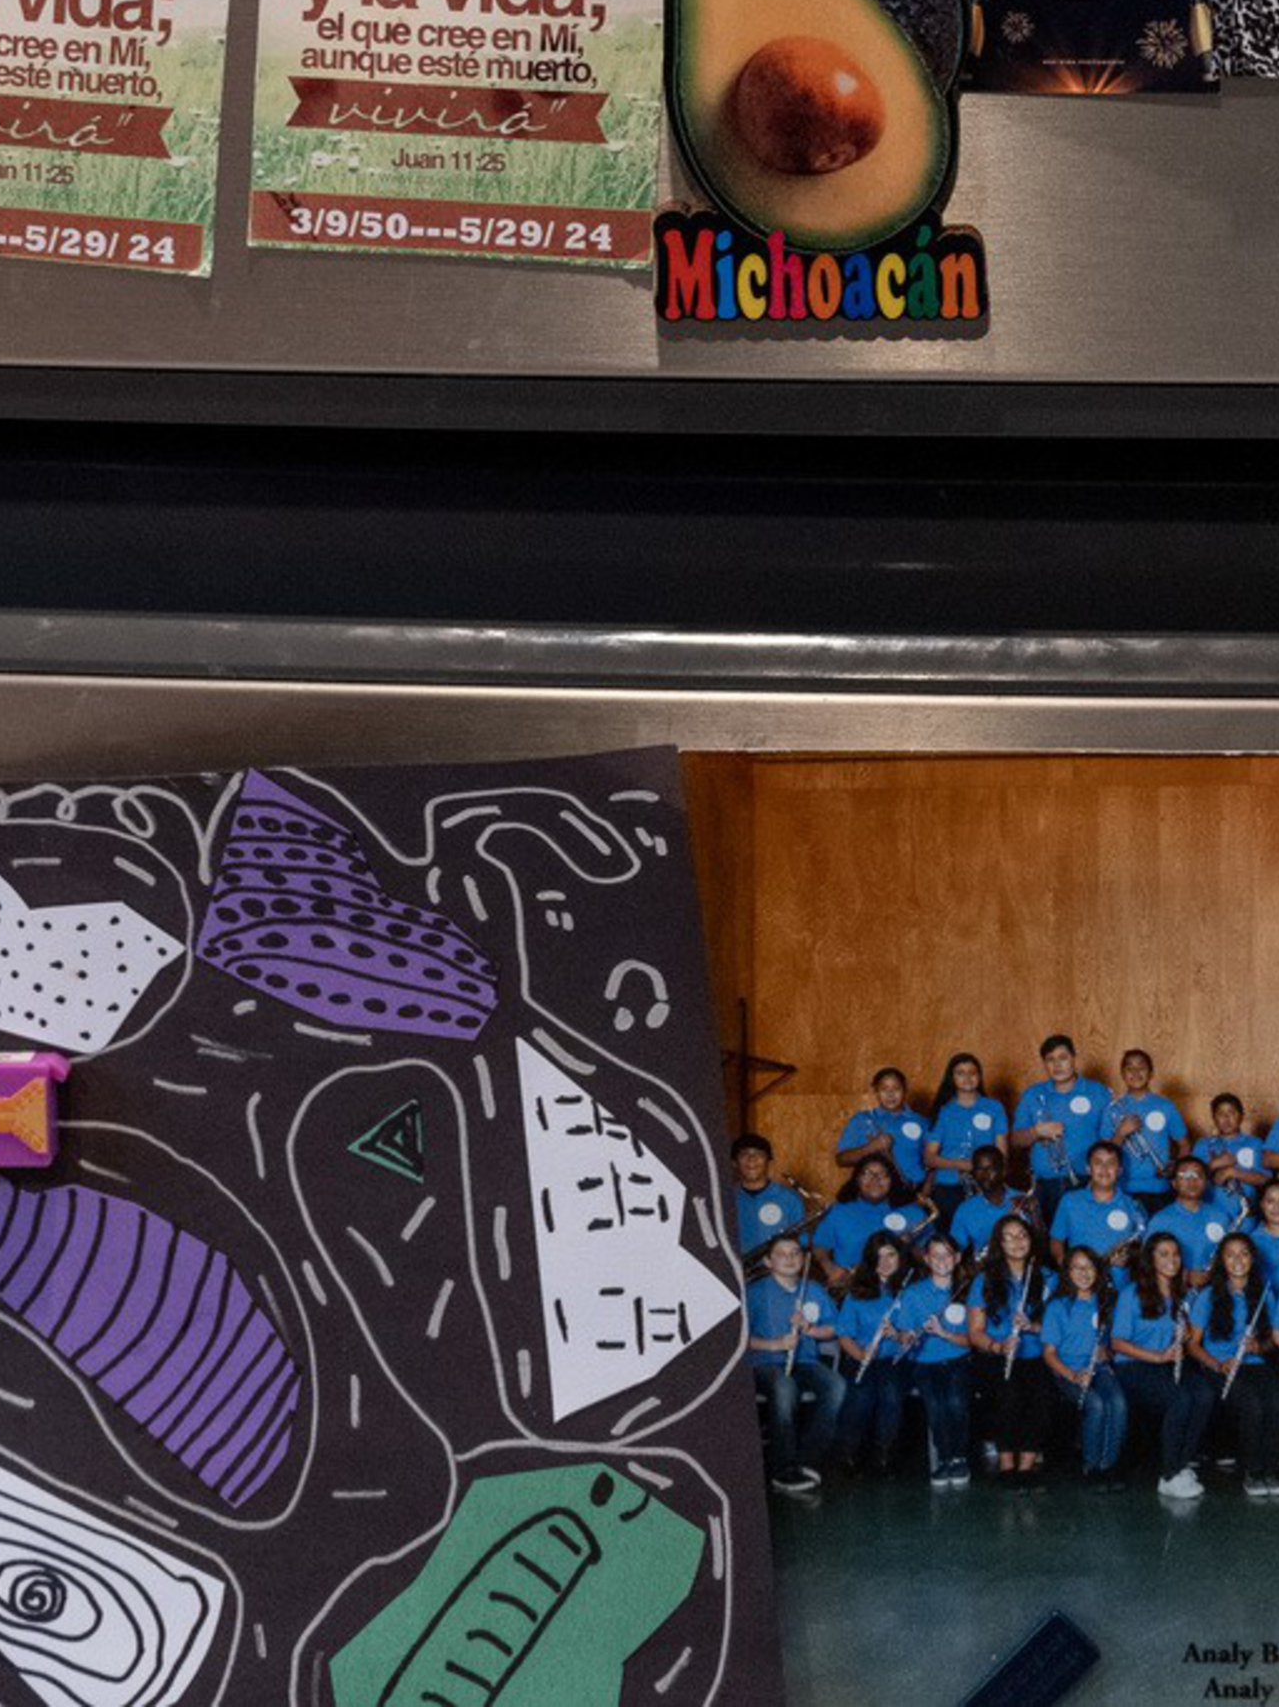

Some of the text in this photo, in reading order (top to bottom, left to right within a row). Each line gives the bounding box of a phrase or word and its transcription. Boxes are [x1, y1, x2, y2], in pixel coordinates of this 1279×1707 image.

[317, 17, 585, 60] el que cree en Mí,
[301, 46, 598, 89] aunque esté muerto,
[391, 147, 506, 173] Juan 11:25
[663, 224, 980, 321] Michoacán
[1182, 1643, 1254, 1669] Analy
